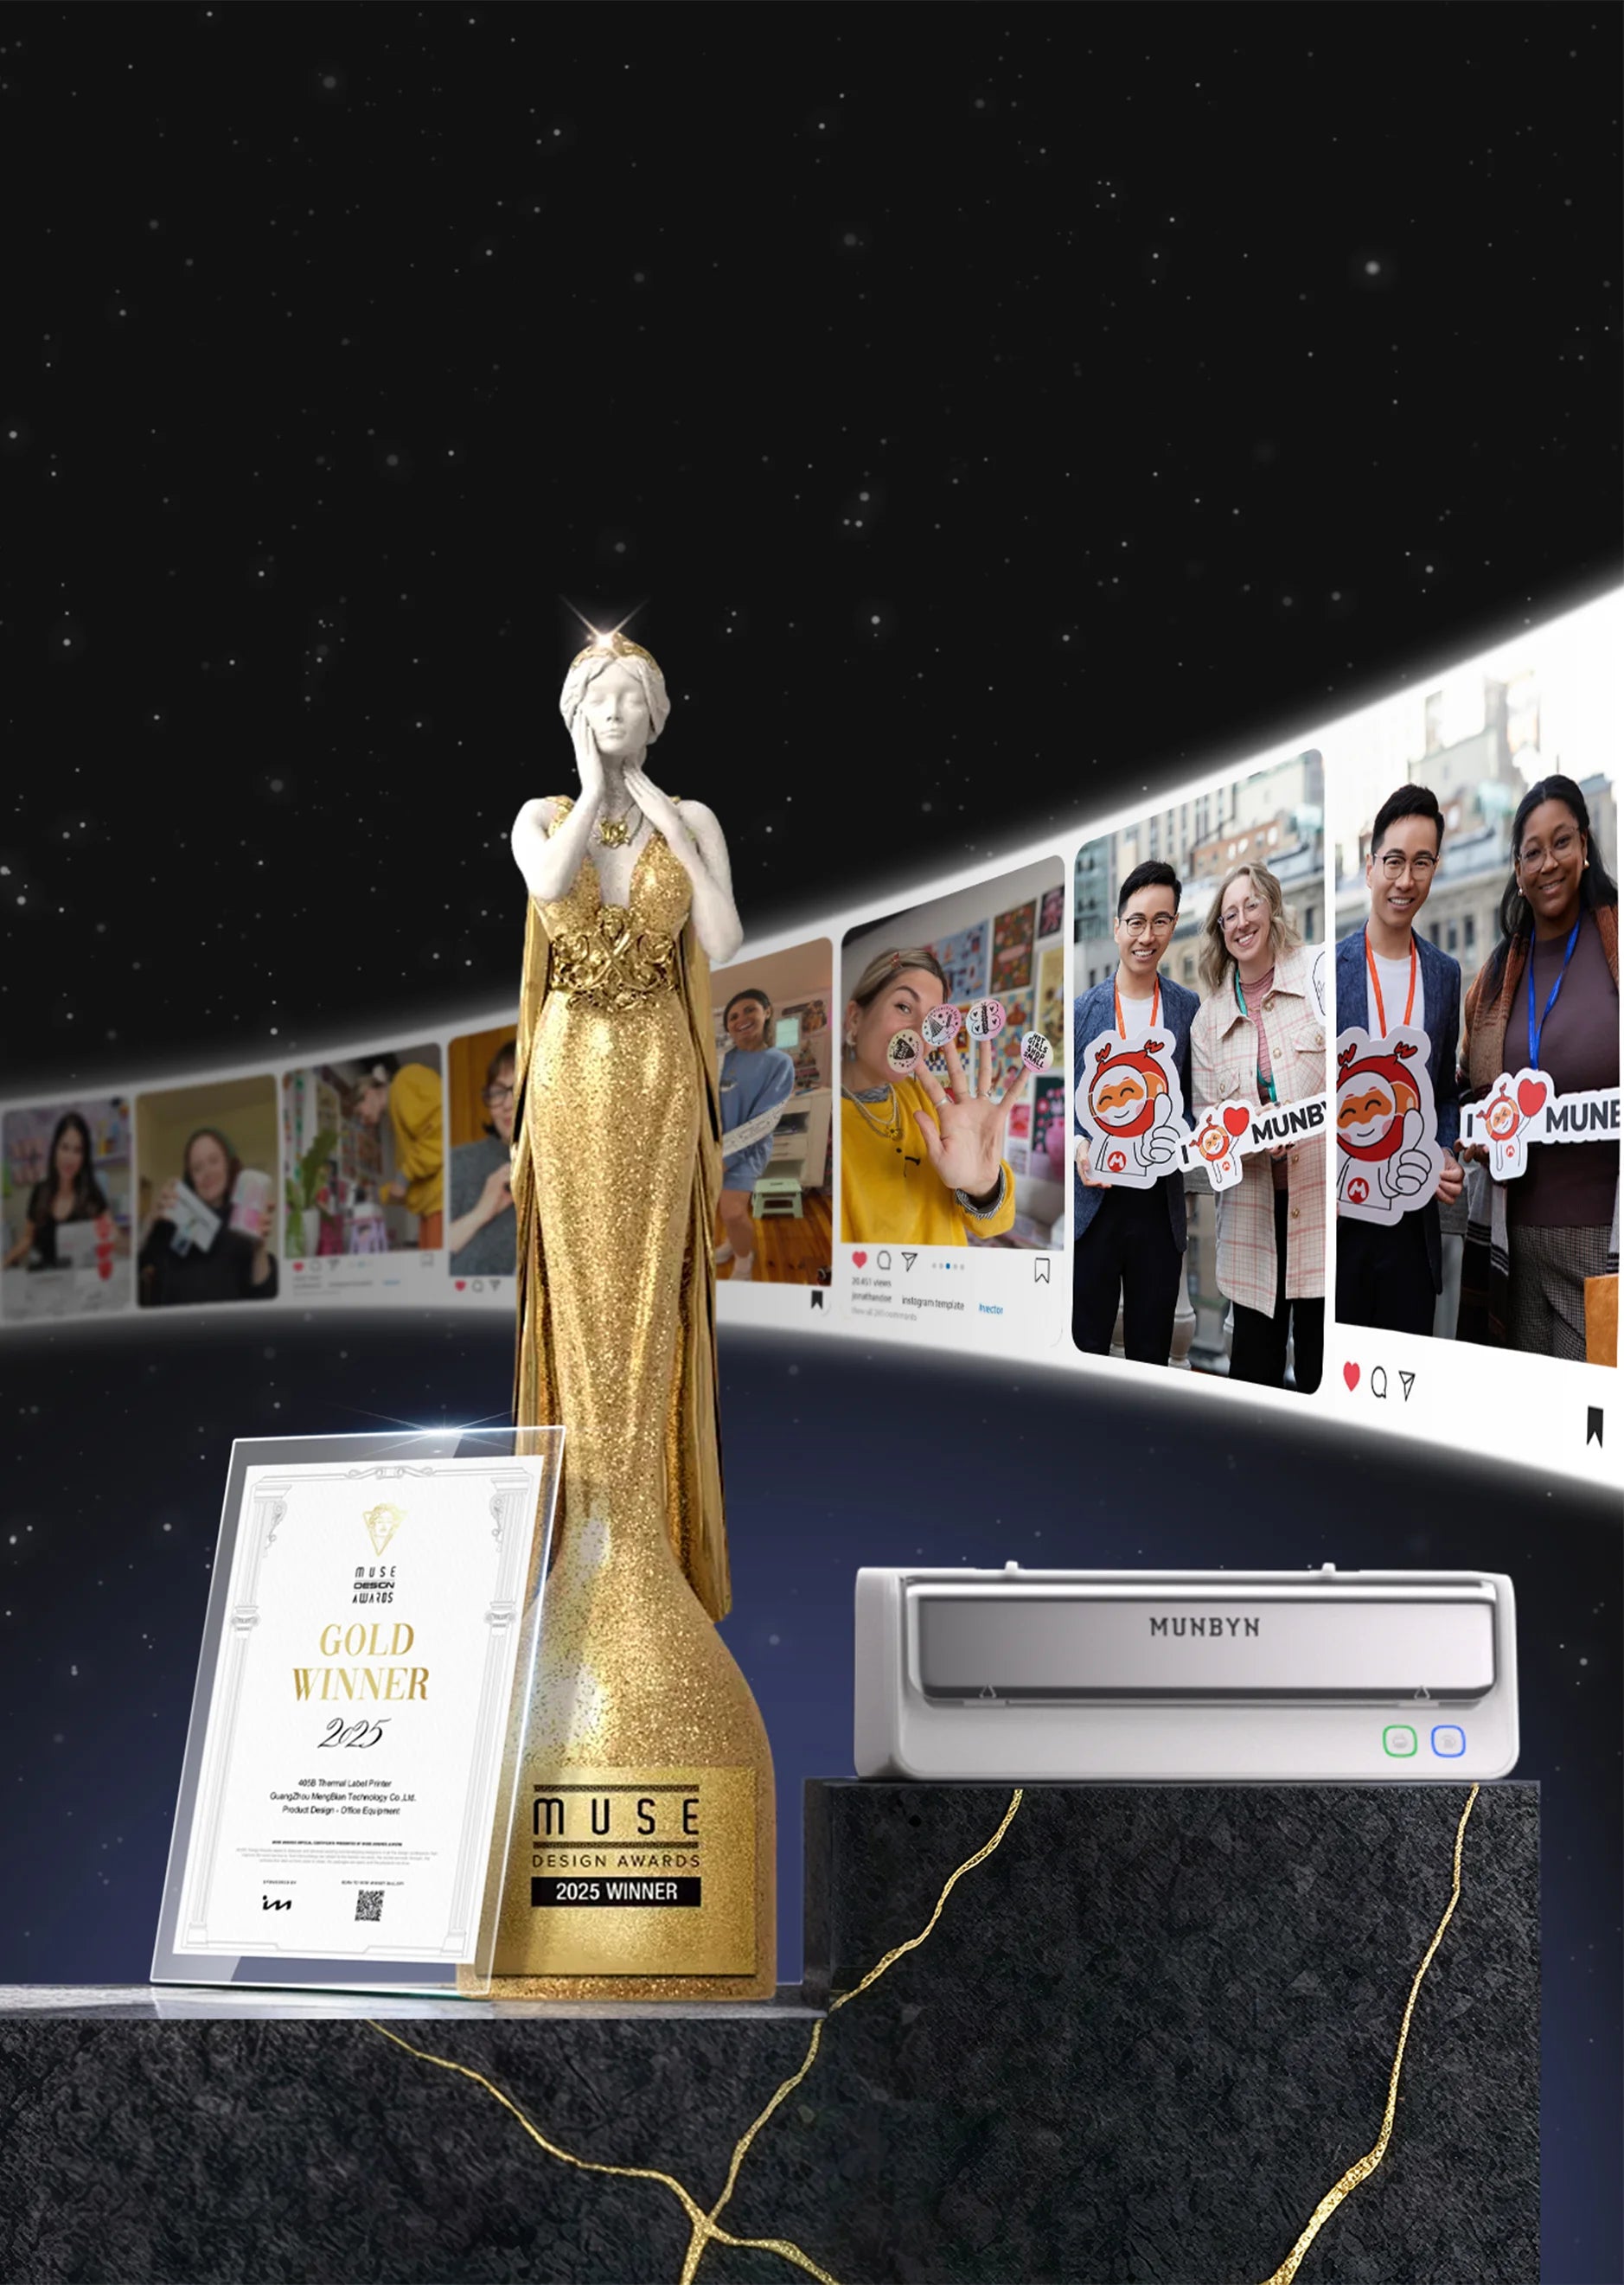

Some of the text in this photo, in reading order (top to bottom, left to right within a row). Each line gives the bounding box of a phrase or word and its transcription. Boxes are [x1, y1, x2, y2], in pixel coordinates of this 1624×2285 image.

[936, 1299, 964, 1311] template
[355, 1565, 396, 1578] MUSE
[1149, 1617, 1260, 1636] MUNBYN
[319, 1623, 414, 1656] GOLD
[292, 1667, 429, 1701] WINNER
[317, 1718, 392, 1749] 2025
[318, 1779, 346, 1788] Thermal
[348, 1779, 368, 1788] Label
[368, 1779, 392, 1788] Printer
[348, 1793, 387, 1803] Technology
[282, 1805, 309, 1814] Product
[310, 1806, 335, 1815] Design
[341, 1806, 361, 1815] Office
[362, 1806, 400, 1816] Equipment
[534, 1798, 699, 1834] MUSE
[533, 1855, 700, 1867] DESIGN AWARDS
[556, 1883, 677, 1900] 2025 WINNER
